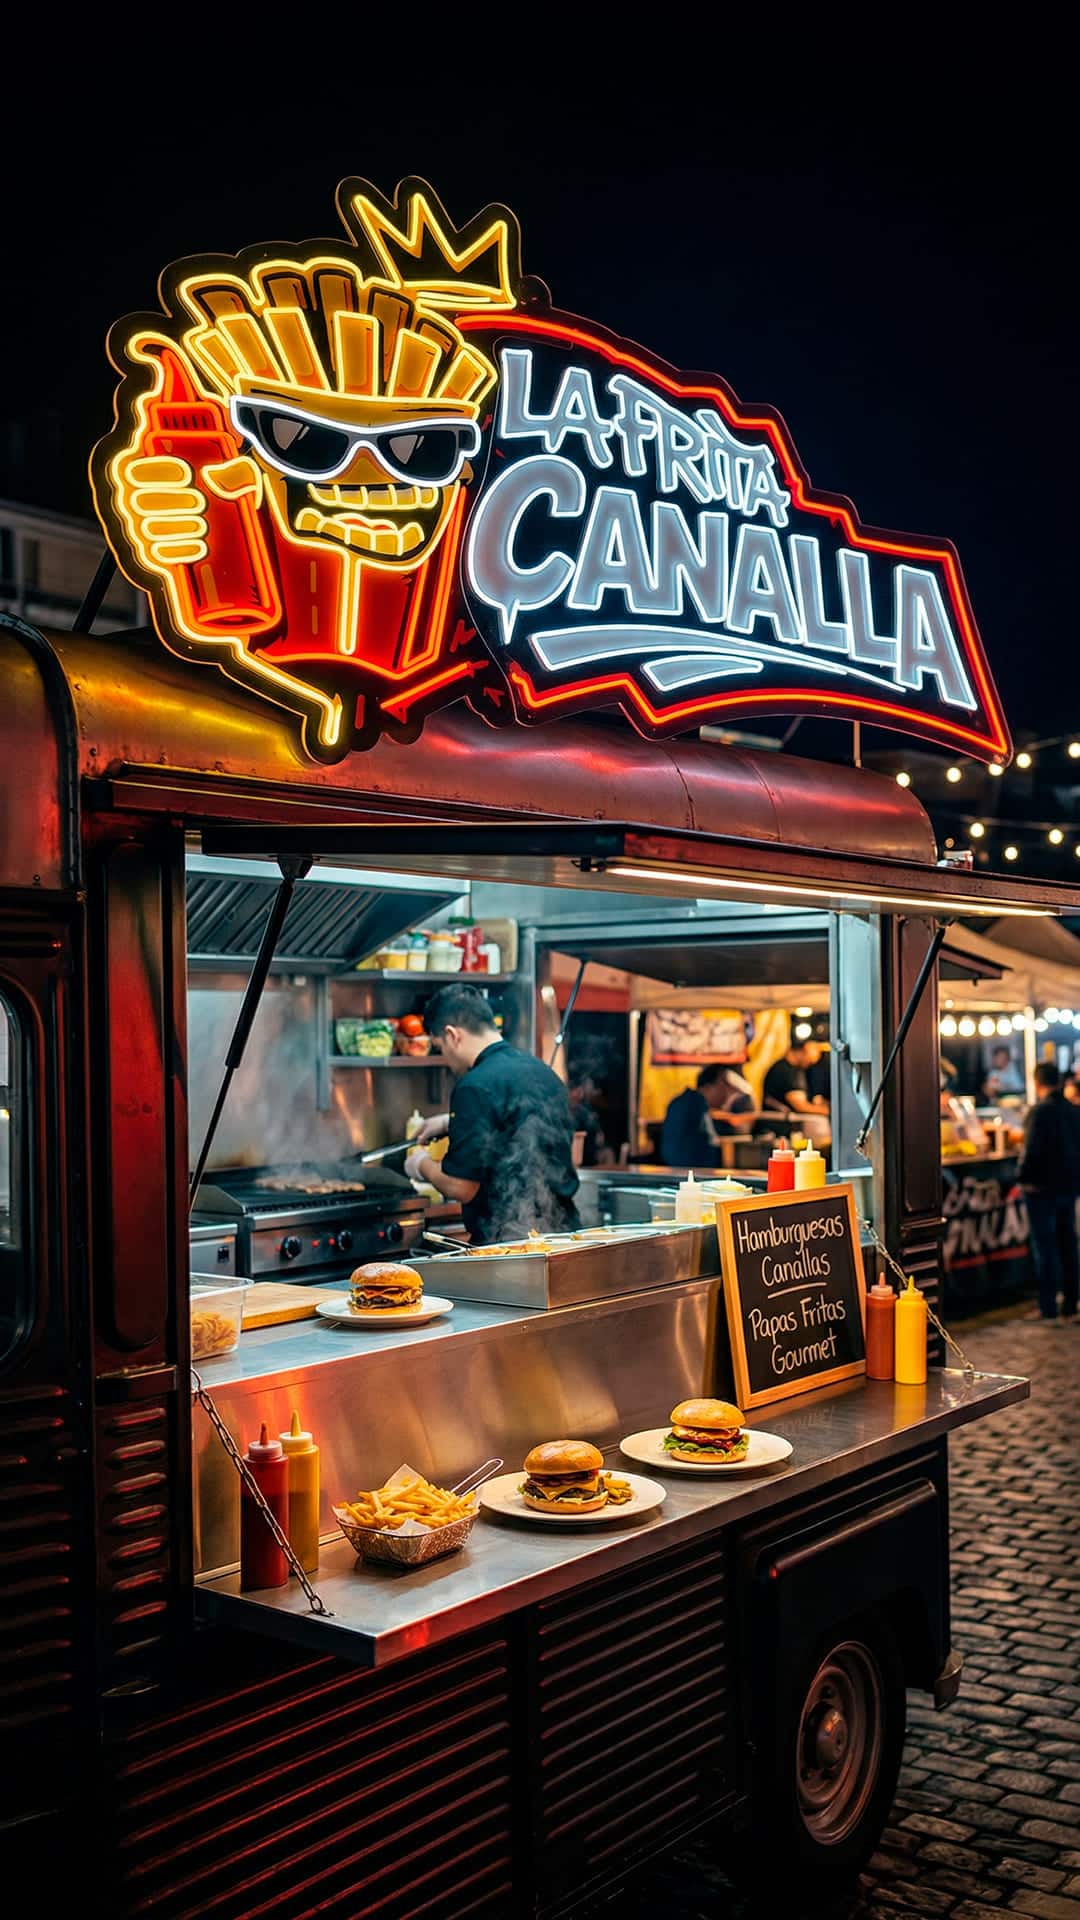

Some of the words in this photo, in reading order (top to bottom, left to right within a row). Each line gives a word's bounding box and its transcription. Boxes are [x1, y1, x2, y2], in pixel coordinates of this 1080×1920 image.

[501, 349, 613, 468] LA
[467, 454, 978, 710] CANALLA
[737, 1215, 844, 1255] Hamburguesas
[761, 1248, 831, 1287] Canallas
[748, 1308, 798, 1345] Papas
[800, 1293, 847, 1328] Fritas
[771, 1328, 837, 1375] Gourmet
